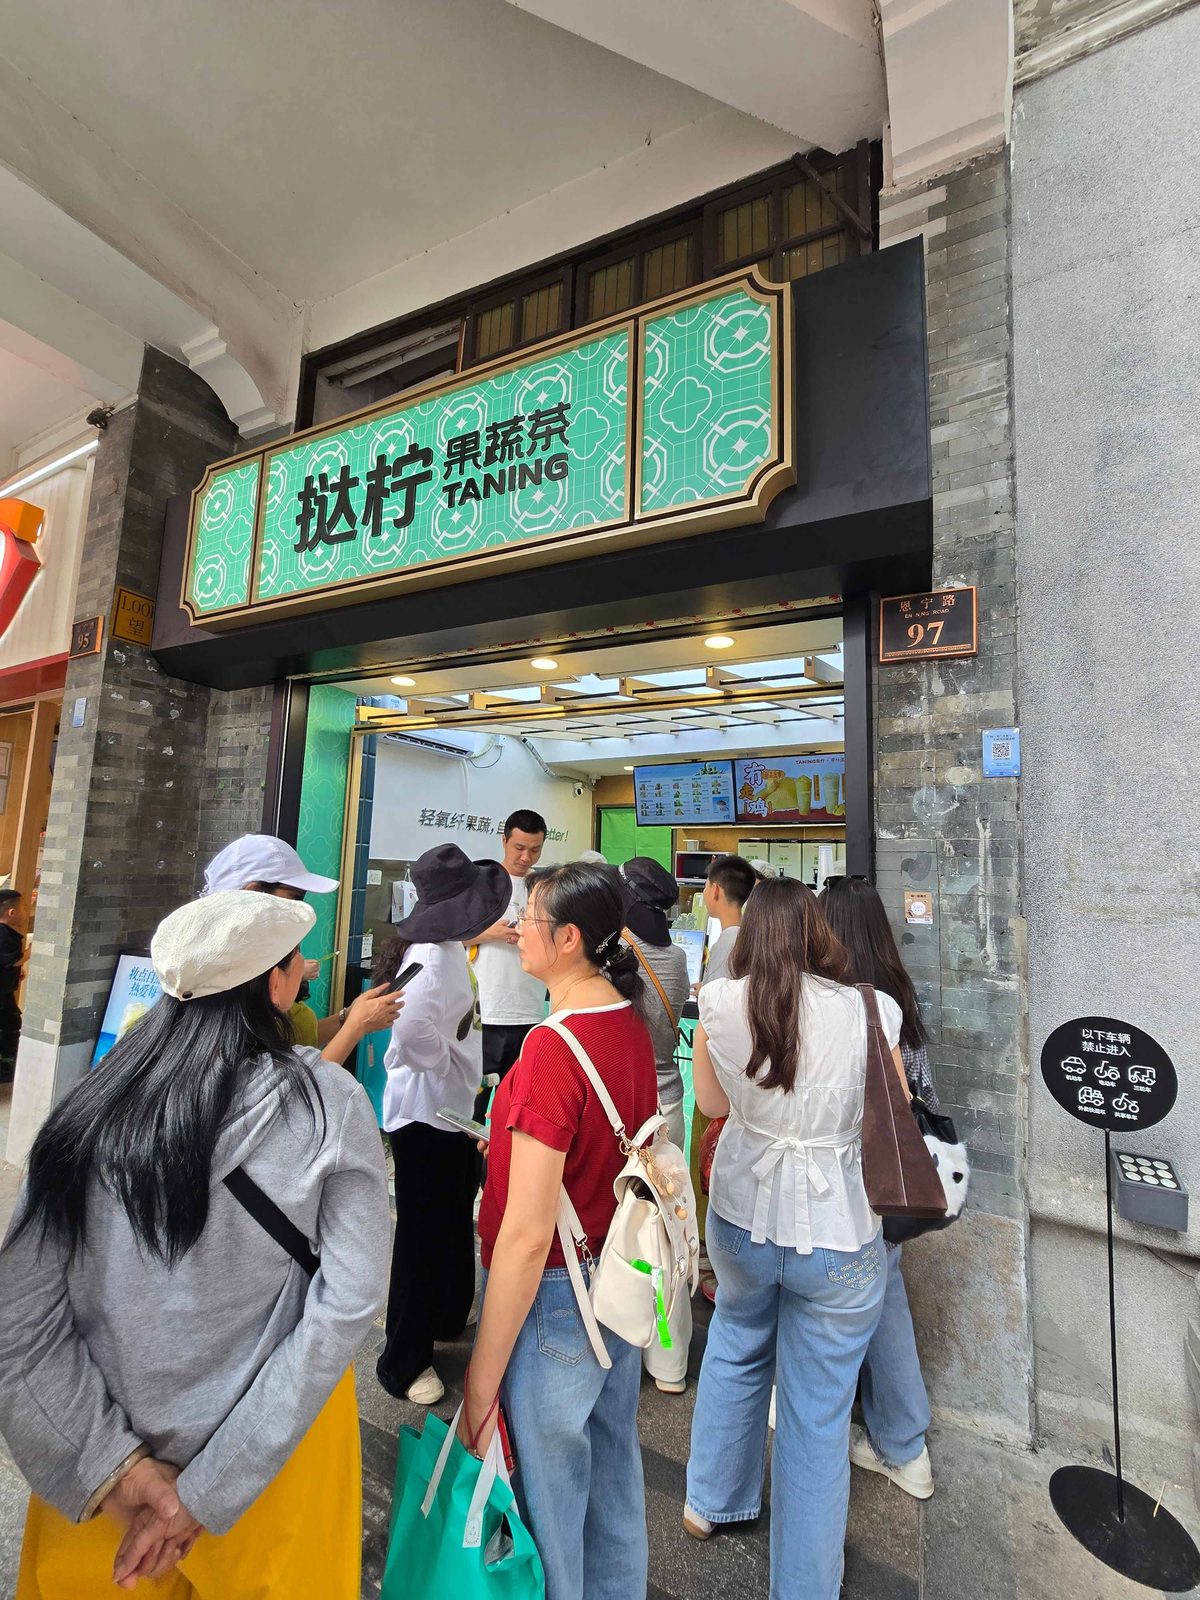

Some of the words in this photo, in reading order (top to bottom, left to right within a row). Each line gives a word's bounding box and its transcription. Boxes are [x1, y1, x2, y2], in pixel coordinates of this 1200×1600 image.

[442, 402, 571, 480] 果蔬茶
[442, 452, 570, 508] TANING
[293, 442, 434, 554] 挞柠
[121, 595, 155, 619] LOO
[77, 632, 92, 650] 95
[906, 620, 945, 648] 97
[545, 827, 569, 842] etter!
[1082, 1028, 1131, 1045] 以下车辆
[1081, 1041, 1132, 1058] 禁止进入
